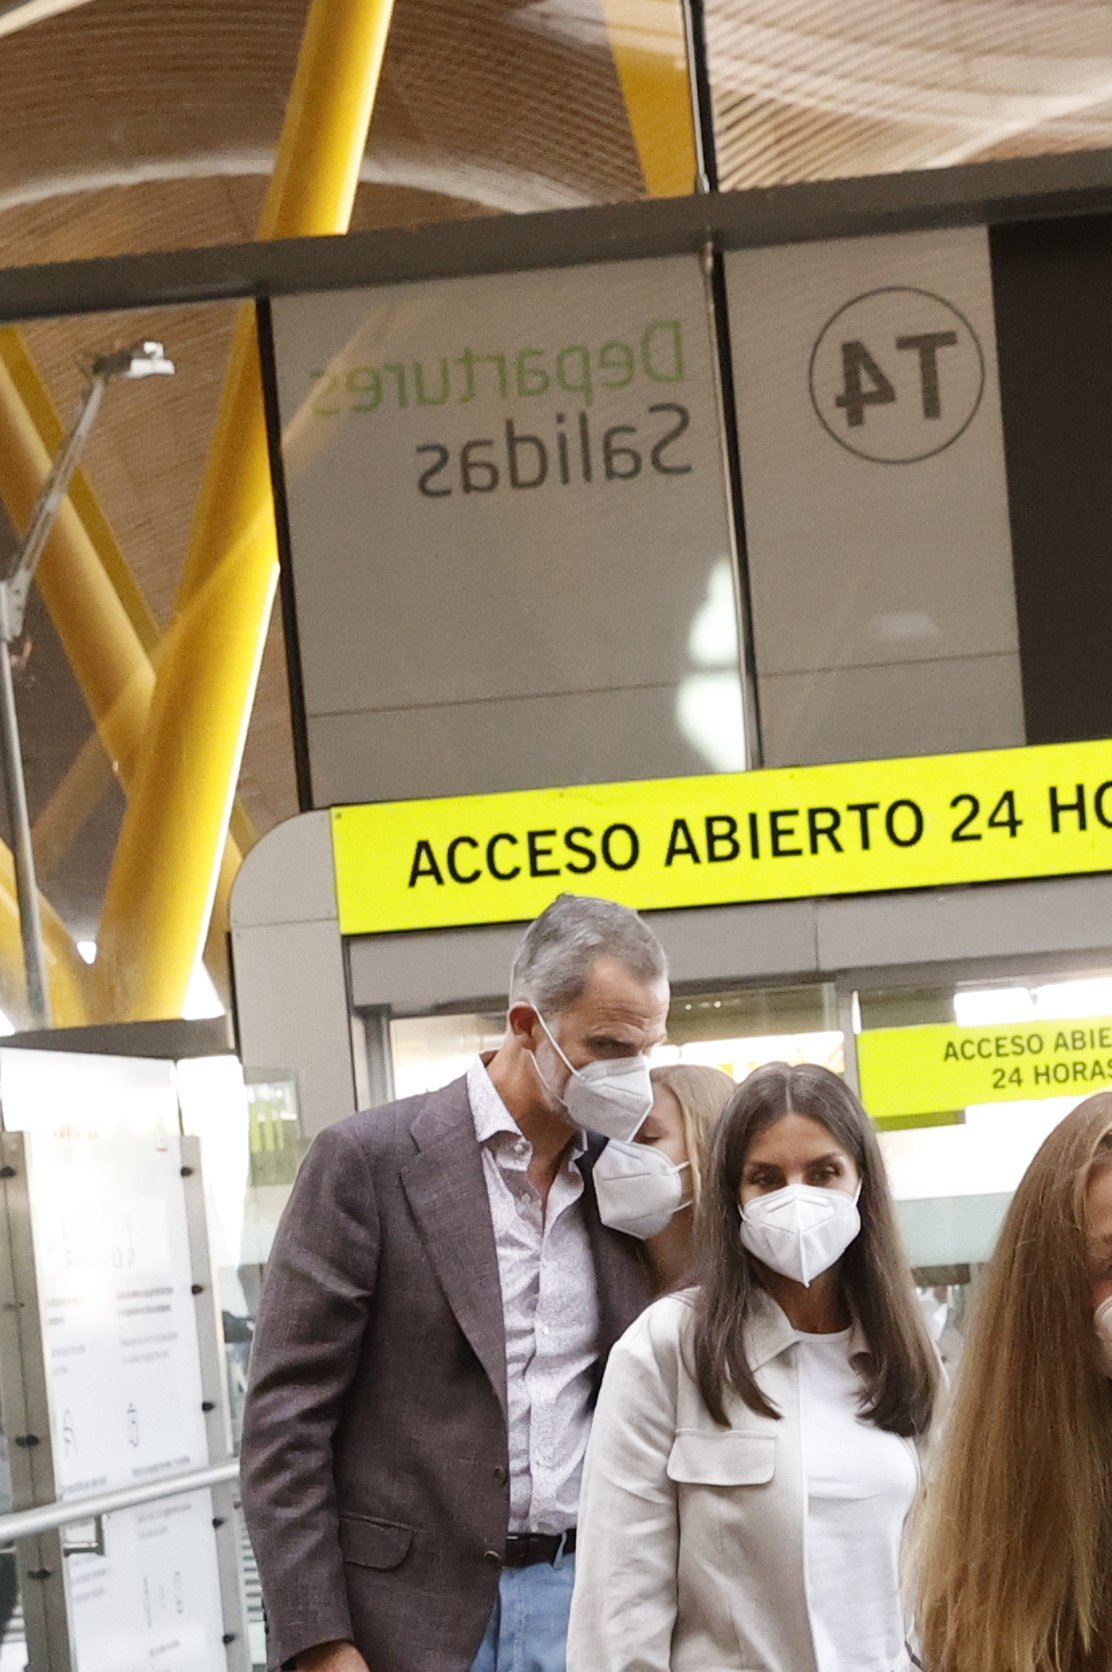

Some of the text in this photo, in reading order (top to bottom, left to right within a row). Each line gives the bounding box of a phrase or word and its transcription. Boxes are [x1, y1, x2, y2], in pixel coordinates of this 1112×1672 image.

[407, 822, 640, 889] ACCESO
[664, 799, 924, 867] ABIERTO
[949, 790, 1024, 843] 24
[943, 1033, 1044, 1062] ACCESO
[991, 1066, 1024, 1089] 24
